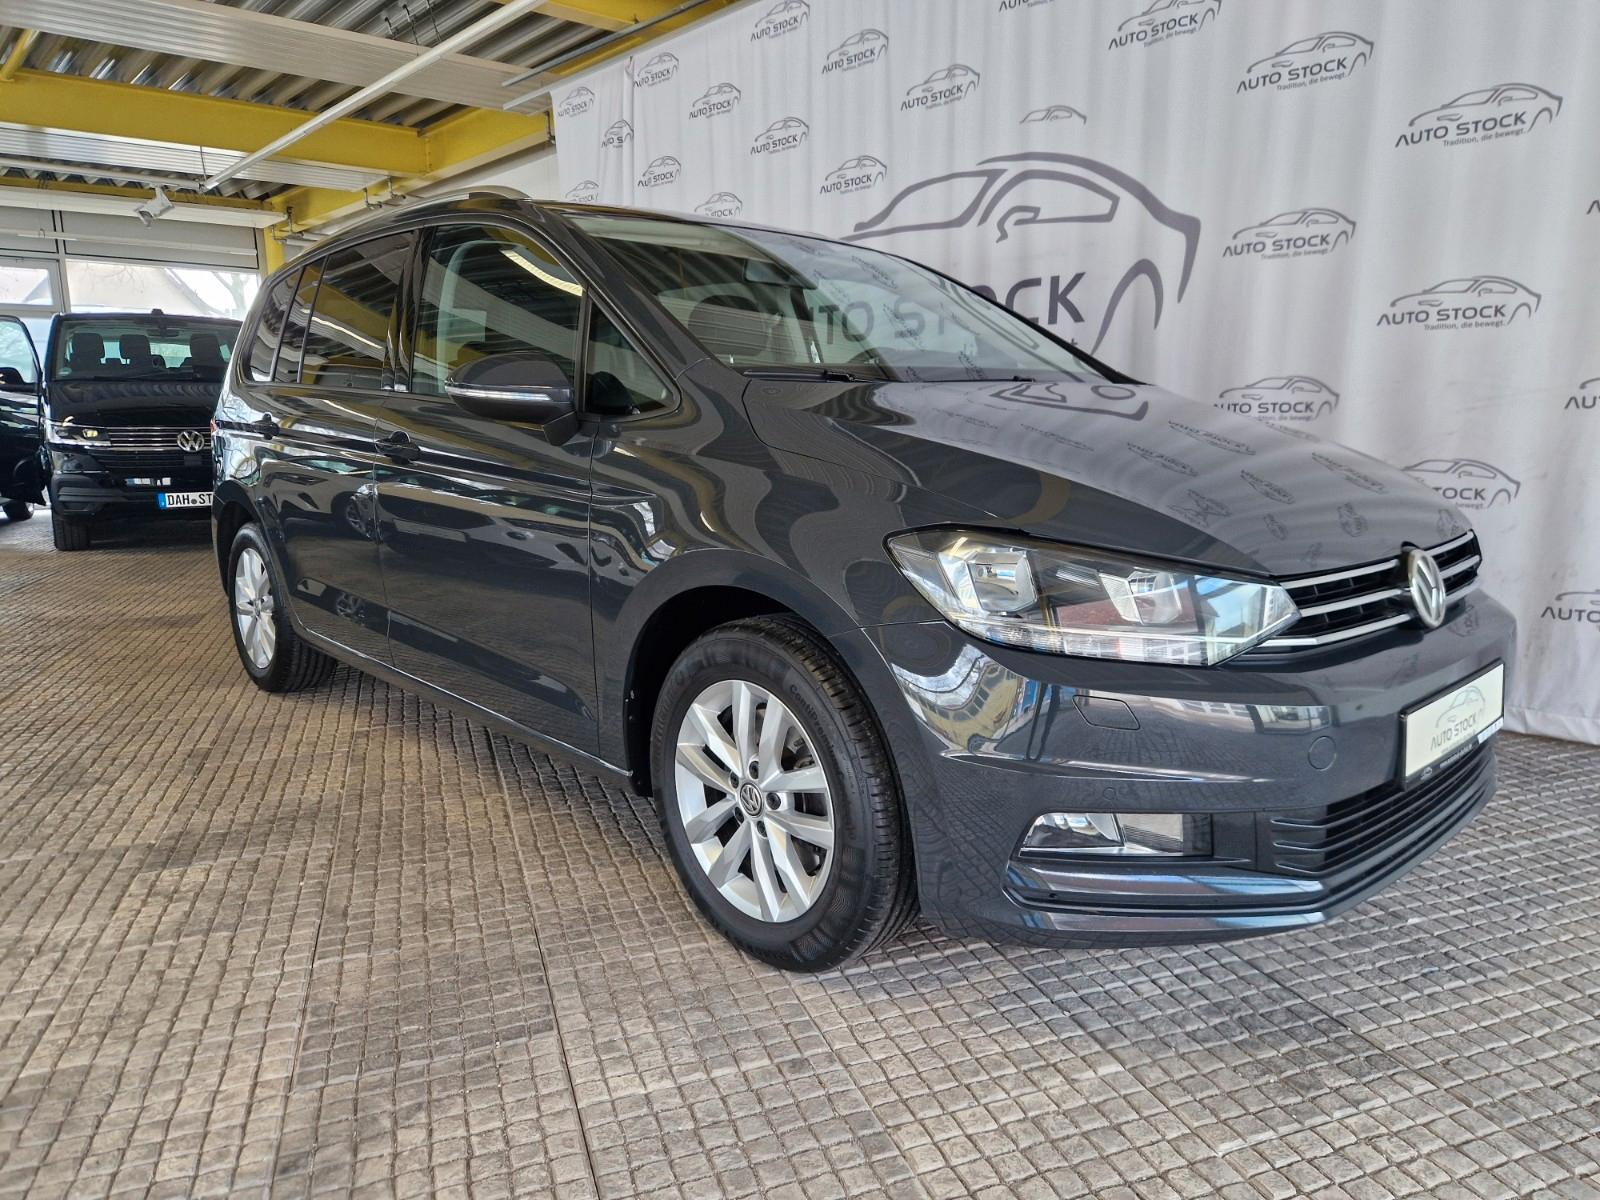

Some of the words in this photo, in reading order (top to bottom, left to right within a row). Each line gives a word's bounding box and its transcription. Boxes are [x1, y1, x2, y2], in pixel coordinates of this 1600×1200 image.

[999, 0, 1029, 12] AUT
[750, 27, 771, 42] AUTO
[773, 15, 799, 32] STOCK
[1108, 30, 1148, 50] AUTO
[1151, 13, 1198, 37] STOCK
[822, 59, 844, 74] AUTO
[847, 47, 876, 65] STOCK
[650, 68, 670, 81] STOCK
[1236, 72, 1281, 94] AUTO
[1288, 57, 1347, 80] STOCK
[900, 96, 928, 111] AUTO
[930, 83, 963, 102] STOCK
[689, 107, 708, 120] AUTO
[708, 99, 731, 113] STOCK
[1395, 126, 1448, 148] AUTO
[1456, 111, 1526, 136] STOCK
[1443, 136, 1479, 147] Tradition,
[1481, 133, 1492, 141] die
[750, 142, 770, 155] AUTO
[772, 134, 798, 149] STOCK
[653, 171, 674, 183] STOCK
[820, 181, 842, 194] AUTO
[844, 173, 872, 188] STOCK
[1222, 241, 1266, 258] AUTO
[1272, 233, 1330, 251] STOCK
[1376, 310, 1430, 326] AUTO
[1436, 304, 1507, 322] STOCK
[1424, 321, 1459, 331] Tradition,
[1460, 320, 1473, 329] die
[1475, 320, 1506, 329] bewegt.
[1258, 401, 1314, 413] STOCK
[1564, 396, 1600, 410] AU
[167, 494, 190, 506] DAH
[199, 493, 213, 505] ST
[1432, 487, 1486, 501] OCK
[1541, 606, 1600, 623] AUTO
[1430, 728, 1453, 752] AUTO
[1454, 712, 1477, 737] STOCK
